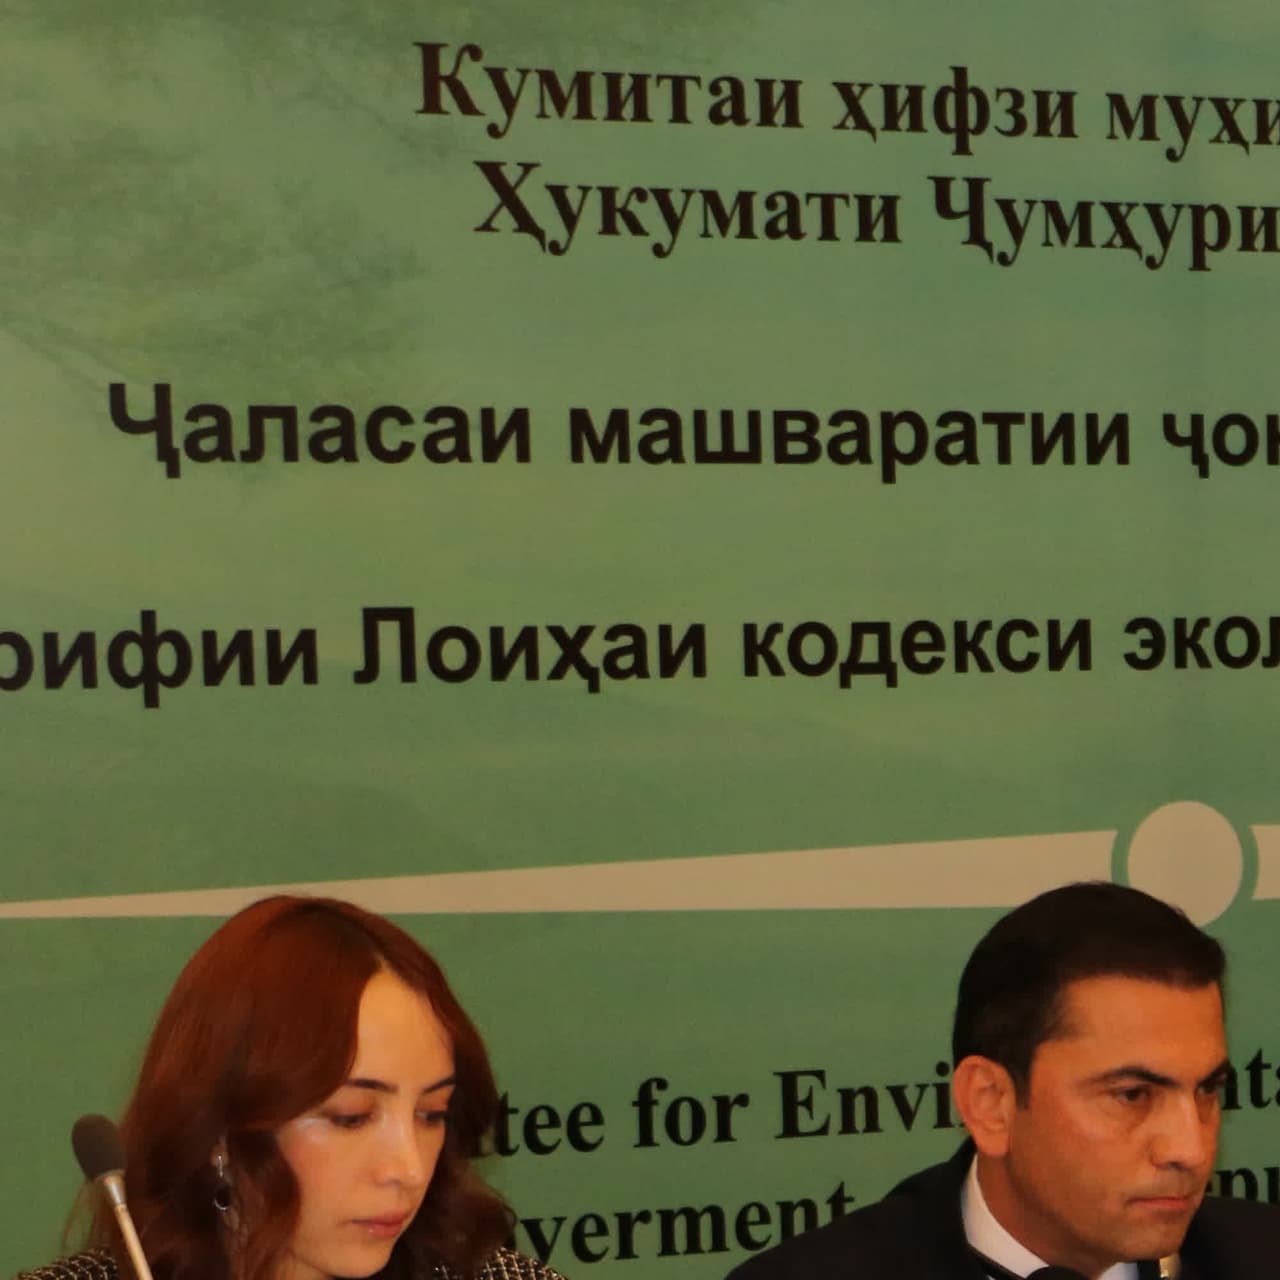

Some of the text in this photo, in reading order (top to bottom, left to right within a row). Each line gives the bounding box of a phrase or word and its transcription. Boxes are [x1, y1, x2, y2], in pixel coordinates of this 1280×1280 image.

[414, 42, 803, 139] Кумитаи
[832, 67, 1078, 155] ҳифзи
[474, 161, 900, 258] Ҳукумати
[110, 383, 530, 478] Ҷаласаи
[570, 408, 1129, 484] машваратии
[354, 607, 706, 693] Лоиҳаи
[744, 619, 1091, 688] кодекси
[632, 1078, 749, 1148] for
